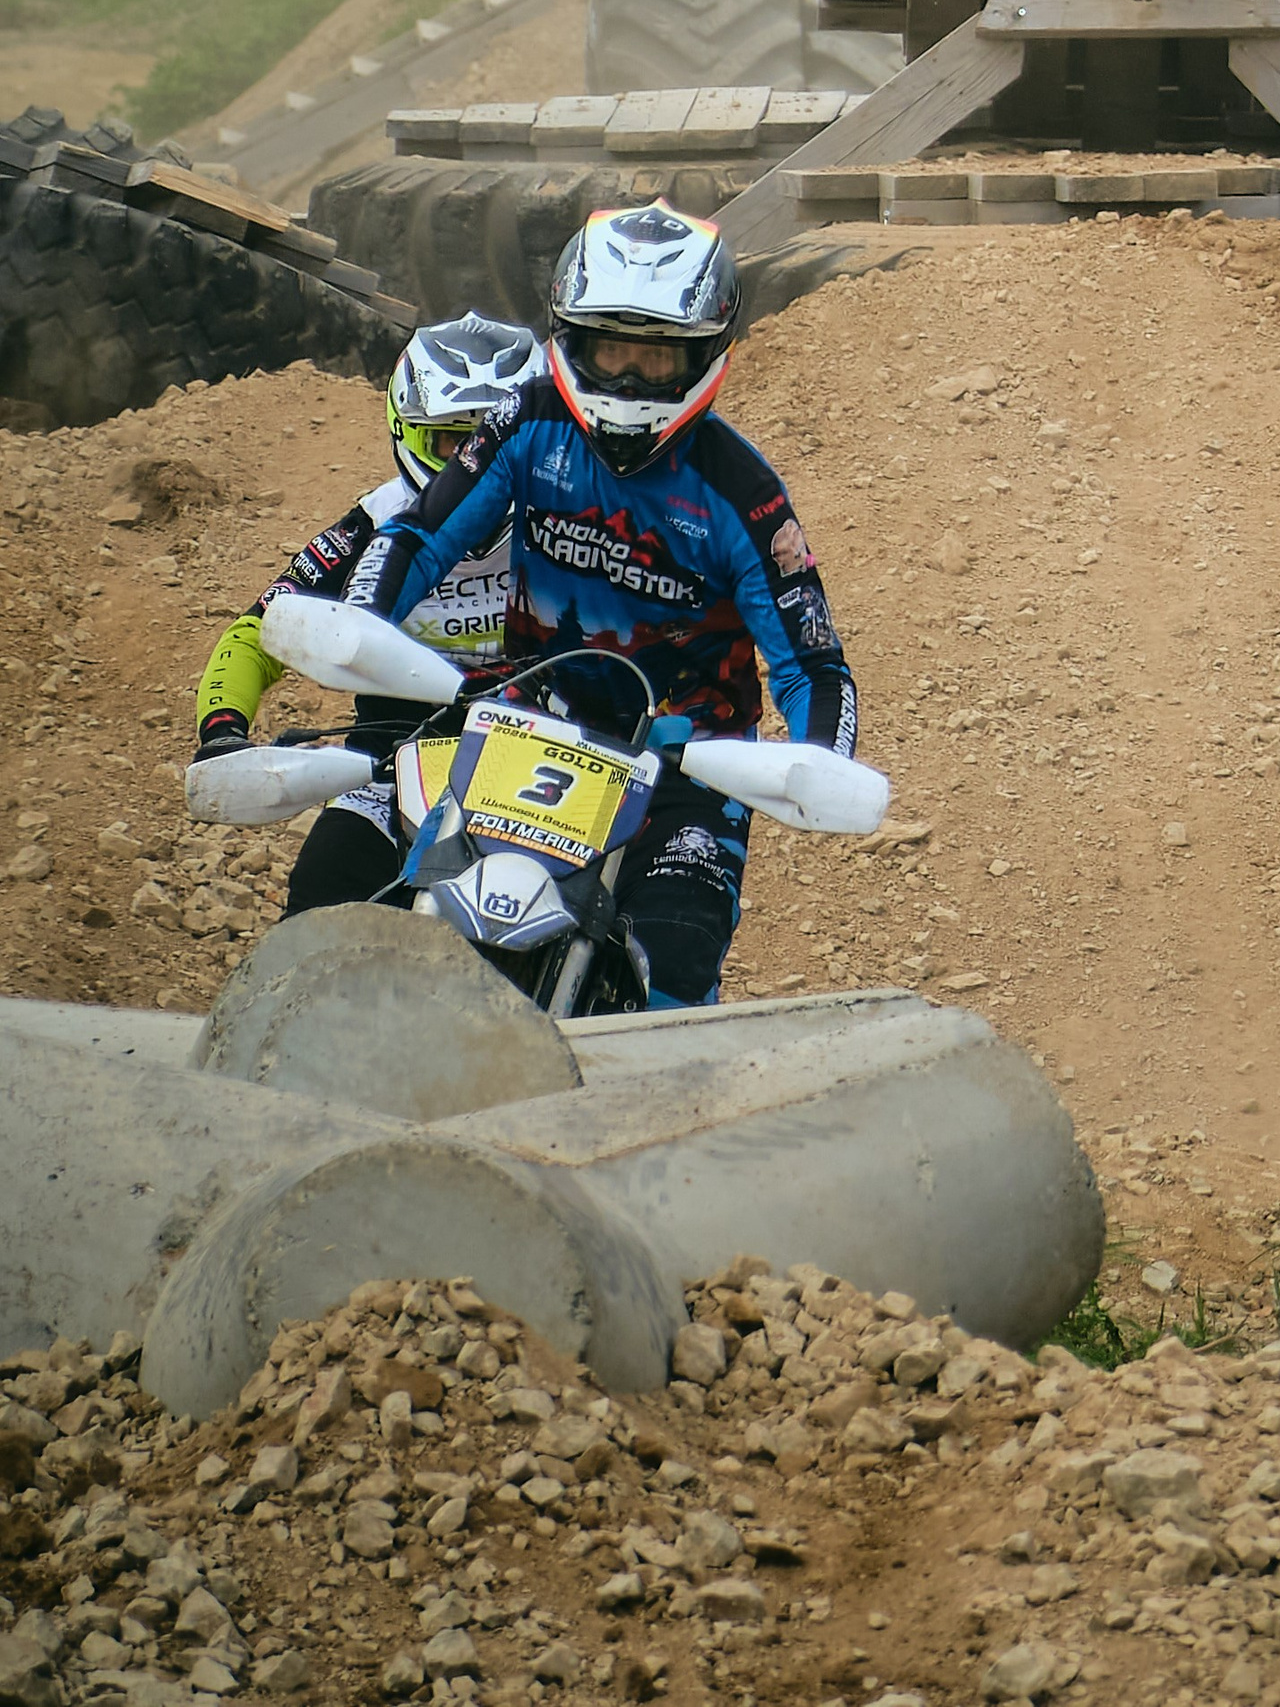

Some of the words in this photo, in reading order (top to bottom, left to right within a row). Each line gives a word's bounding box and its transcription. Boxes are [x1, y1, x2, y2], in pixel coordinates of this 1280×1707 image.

[478, 711, 536, 731] ONLY1
[544, 747, 604, 774] GOLD
[517, 766, 574, 806] 3
[469, 812, 594, 860] POLYMERIUM
[542, 814, 587, 835] Вадим
